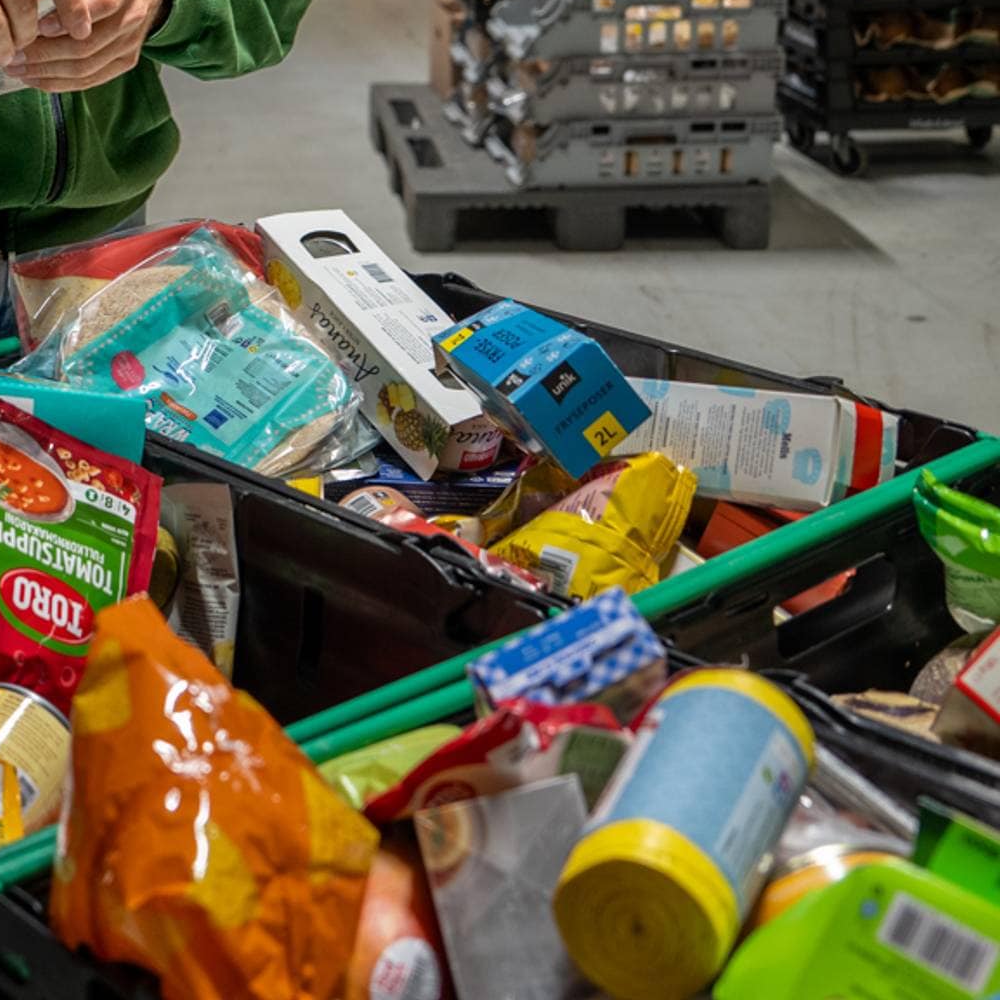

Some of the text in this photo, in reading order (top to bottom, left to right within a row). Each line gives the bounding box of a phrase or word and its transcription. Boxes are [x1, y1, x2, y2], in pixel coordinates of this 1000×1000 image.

[307, 302, 380, 382] Ananas
[552, 371, 577, 397] unik
[594, 426, 618, 447] 2L
[103, 496, 113, 509] 8
[12, 576, 83, 638] TORO
